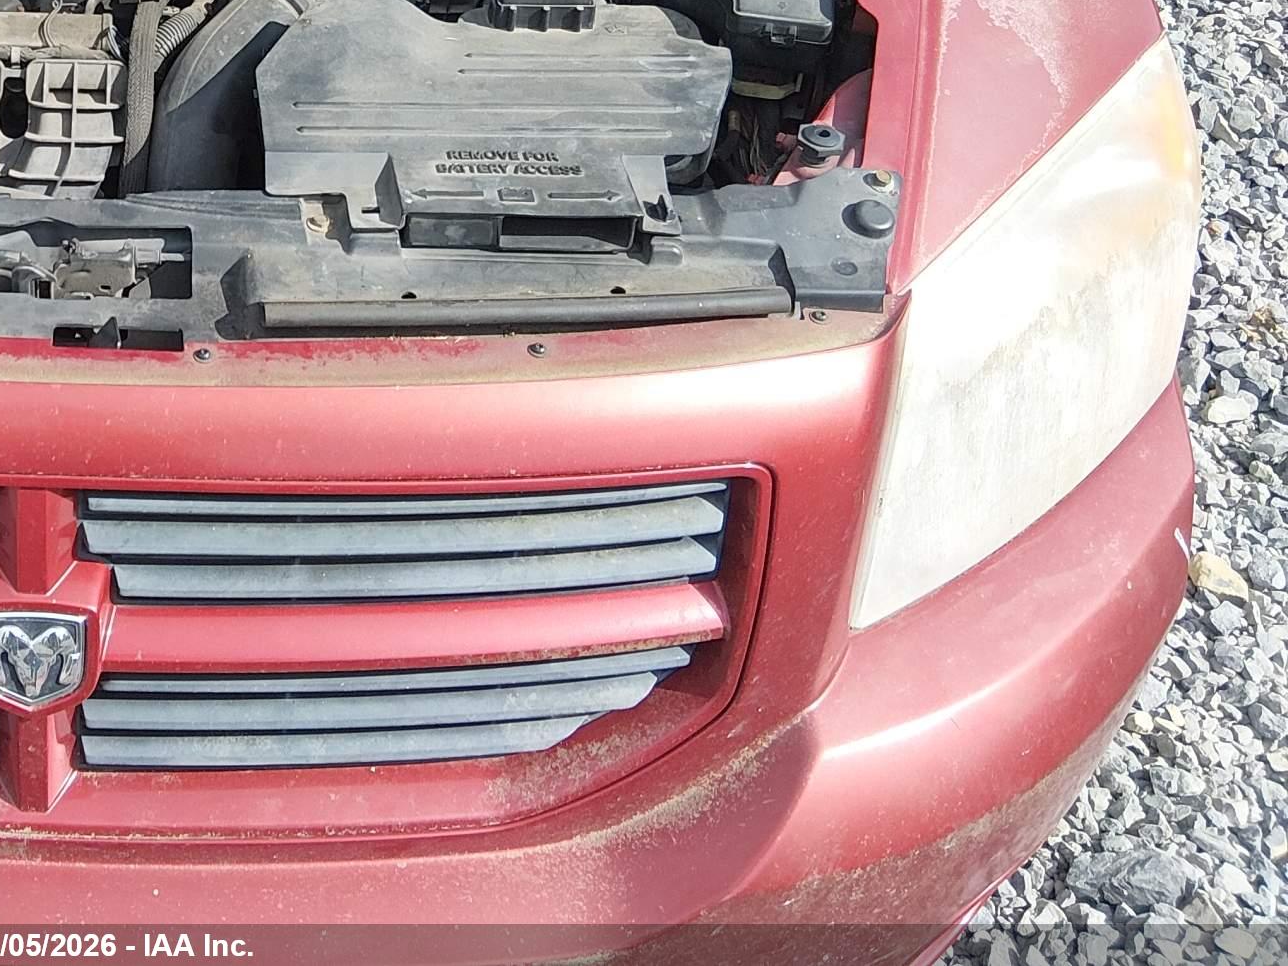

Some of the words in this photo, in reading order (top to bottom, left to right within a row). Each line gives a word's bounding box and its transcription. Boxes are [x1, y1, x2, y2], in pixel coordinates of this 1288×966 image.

[445, 150, 520, 161] REMOVE
[522, 151, 560, 162] FOR
[435, 163, 509, 175] BATTERY
[513, 164, 584, 176] ACCESS
